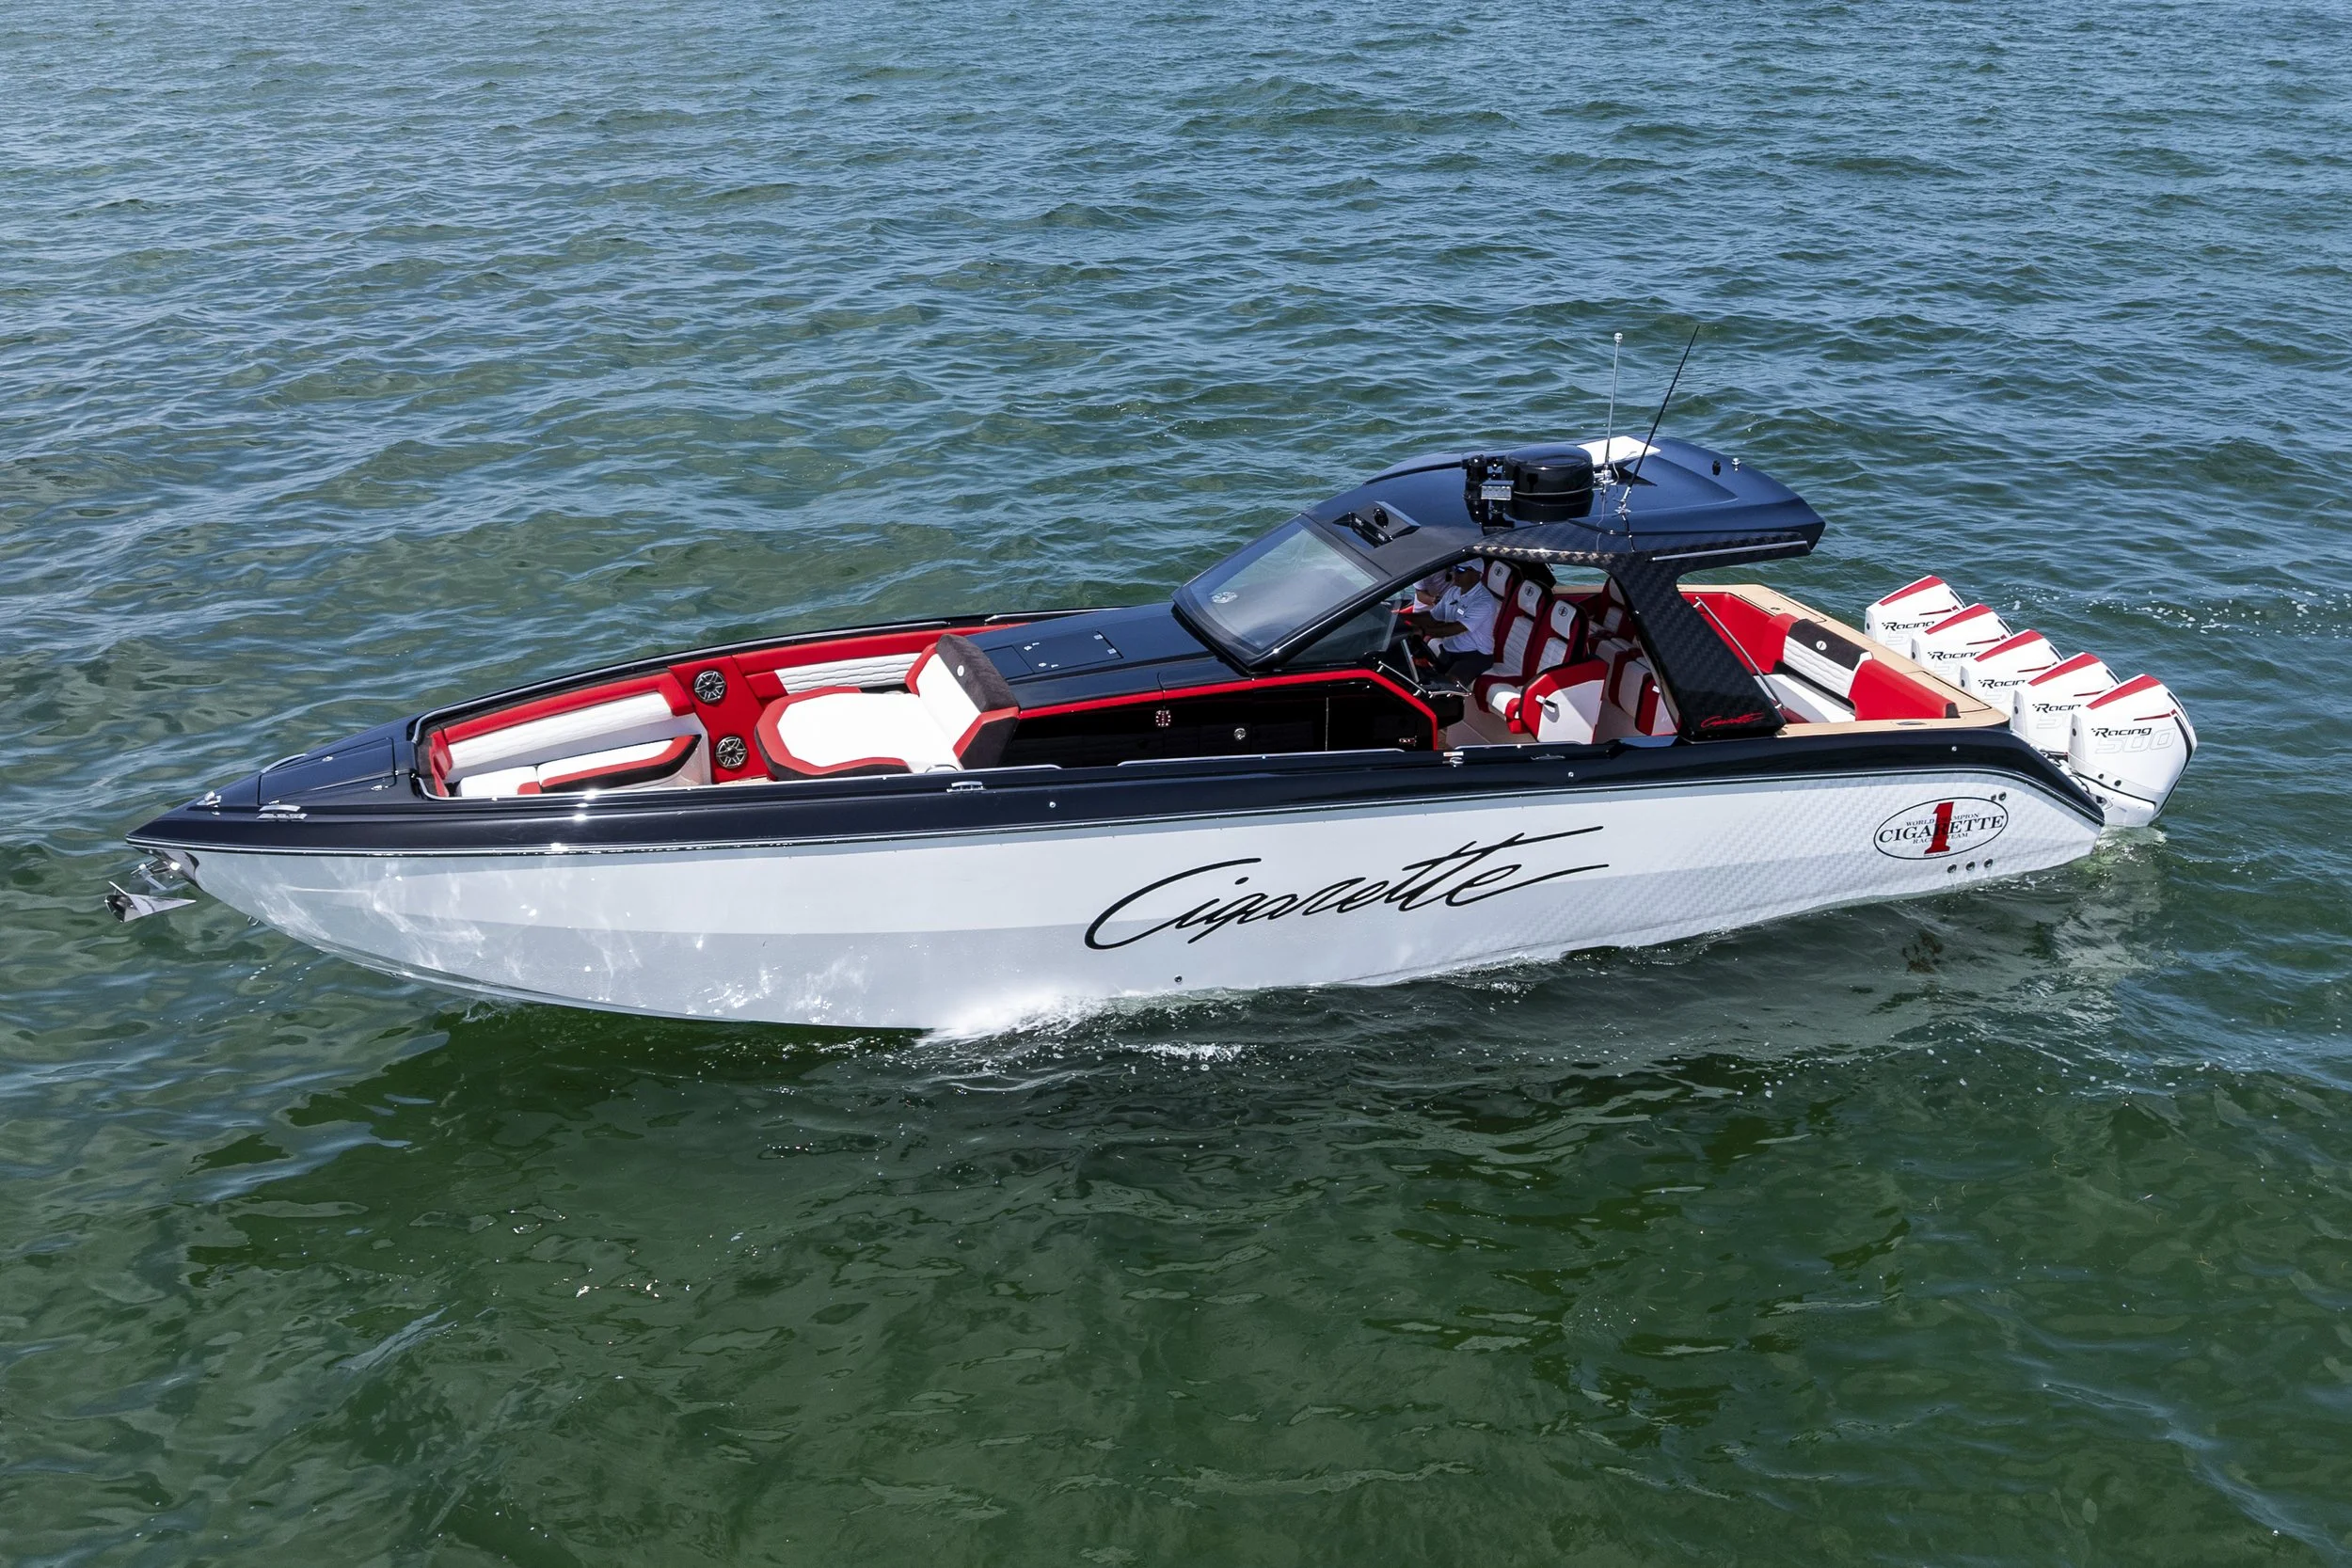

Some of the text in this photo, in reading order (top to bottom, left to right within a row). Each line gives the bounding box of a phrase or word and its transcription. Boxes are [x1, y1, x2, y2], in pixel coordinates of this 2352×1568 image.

[2091, 727, 2153, 737] Racing
[2094, 727, 2176, 753] 500
[1906, 817, 1935, 827] WORLD
[1084, 826, 1610, 950] Cigarette
